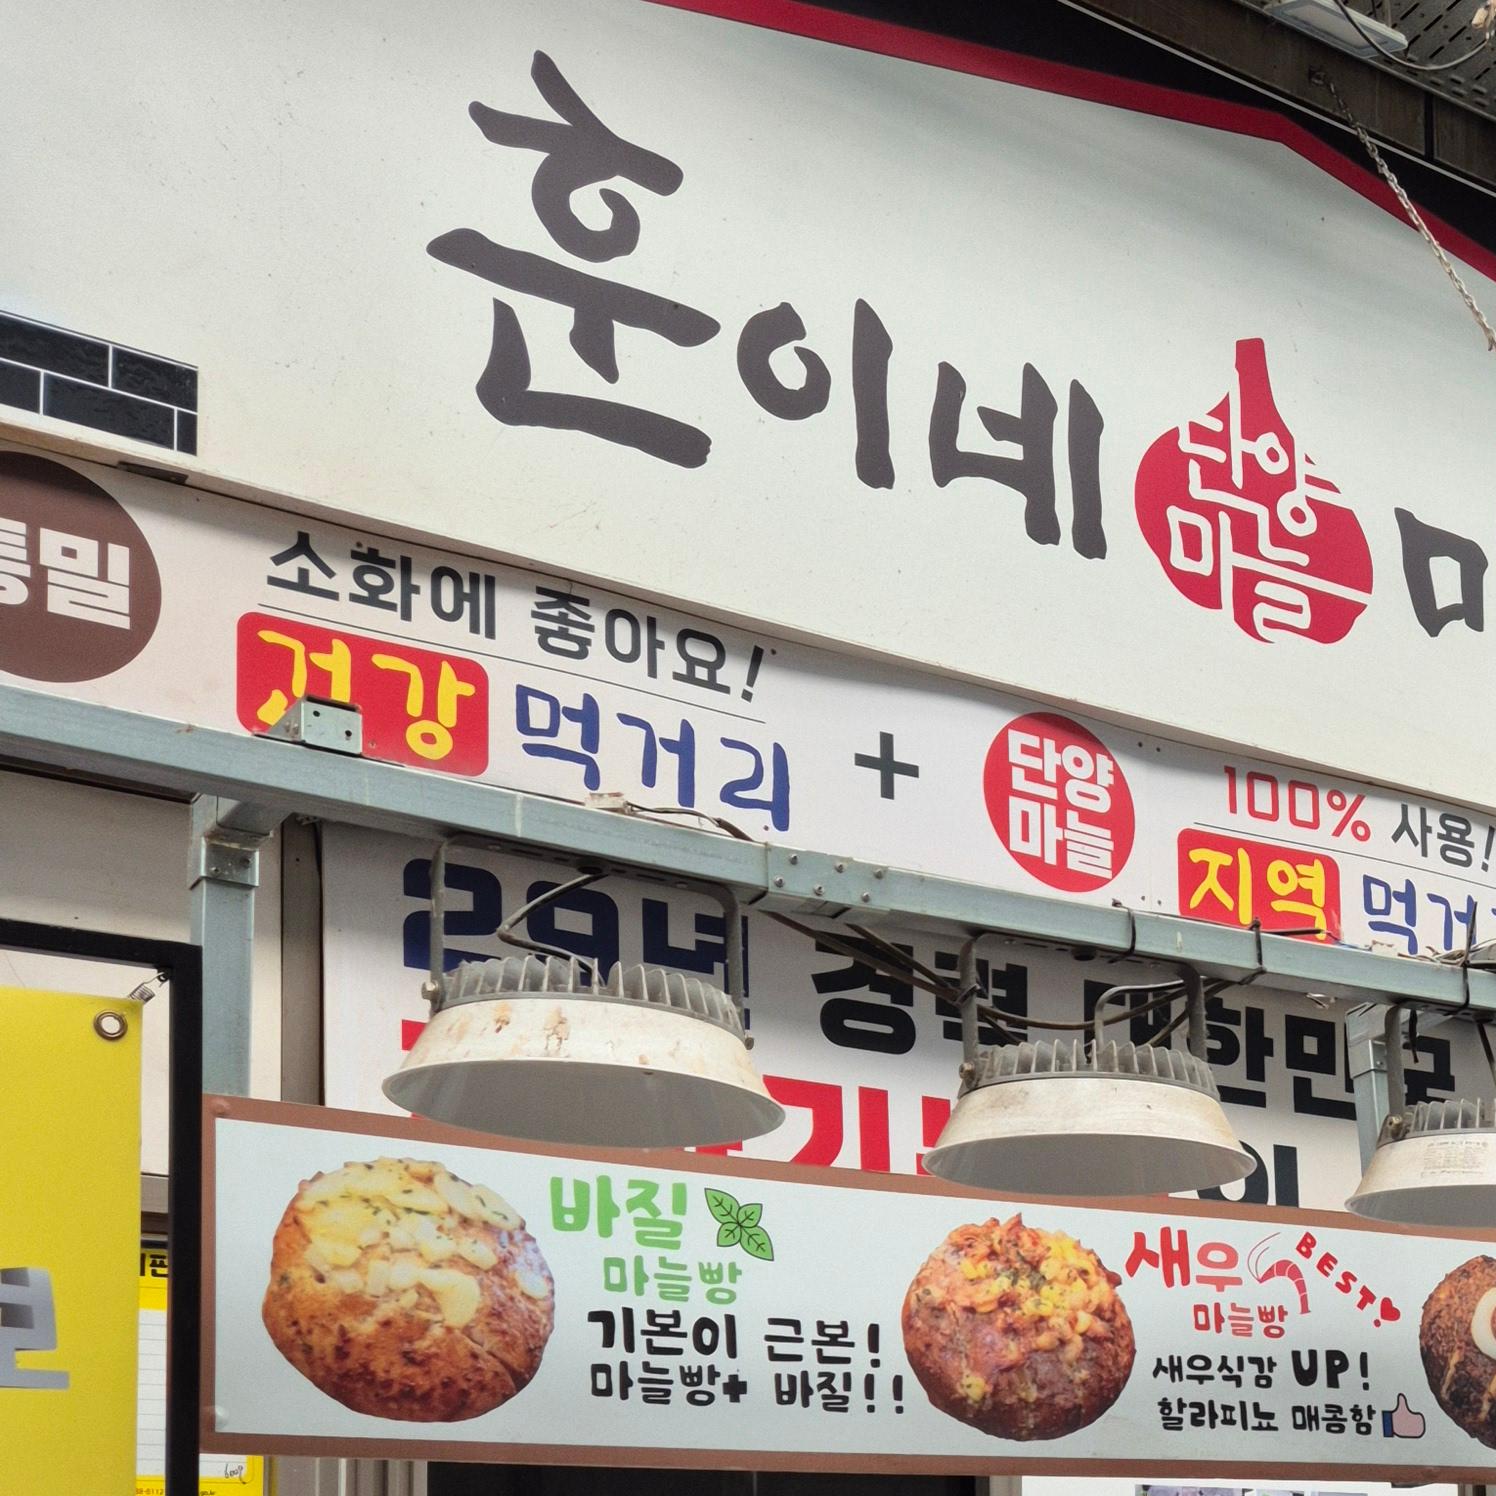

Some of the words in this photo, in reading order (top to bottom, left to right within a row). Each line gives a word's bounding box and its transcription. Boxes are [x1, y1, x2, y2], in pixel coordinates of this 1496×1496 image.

[427, 50, 1106, 560] 훈이네
[267, 531, 497, 642] 소화에
[530, 582, 766, 703] 좋아요!
[257, 628, 474, 761] 건강
[515, 683, 790, 832] 먹거리
[1007, 729, 1114, 814] 단양
[1224, 766, 1371, 843] 100%
[1009, 798, 1113, 881] 마늘
[1188, 848, 1326, 941] 지역
[549, 1174, 688, 1250] 바질
[603, 1255, 742, 1305] 마늘빵
[1125, 1226, 1243, 1293] 새우
[587, 1306, 738, 1360] 기본이
[763, 1316, 881, 1369] 근본!
[1193, 1301, 1289, 1339] 마늘빵
[774, 1370, 905, 1415] 바질!!
[1152, 1354, 1278, 1390] 새우식감
[1291, 1350, 1371, 1391] UP!
[1157, 1396, 1280, 1433] 할라피뇨
